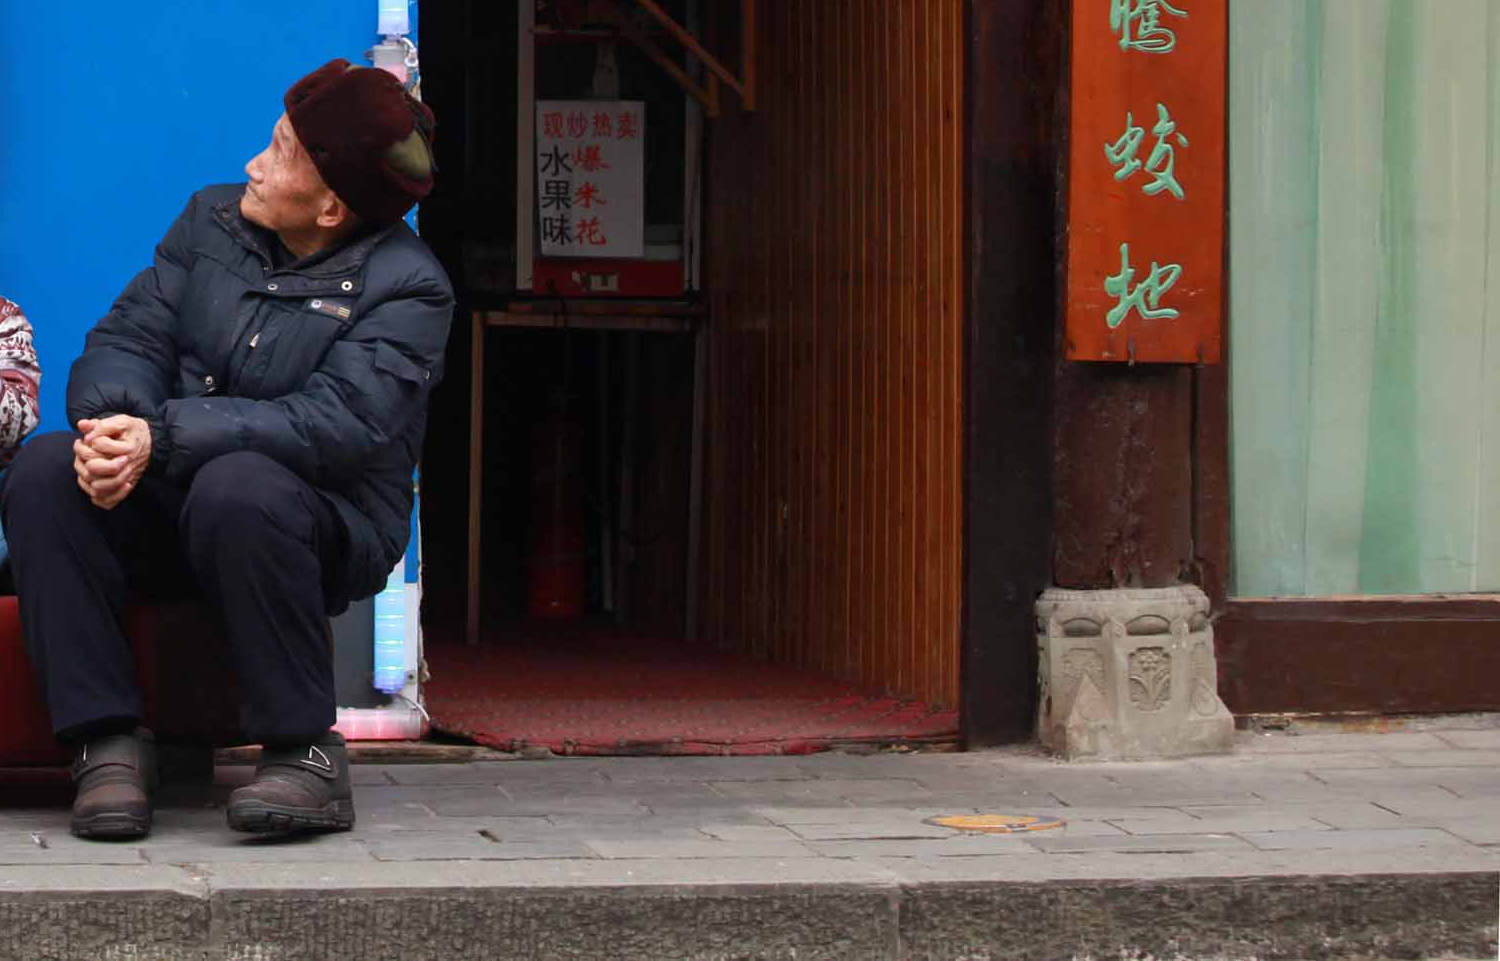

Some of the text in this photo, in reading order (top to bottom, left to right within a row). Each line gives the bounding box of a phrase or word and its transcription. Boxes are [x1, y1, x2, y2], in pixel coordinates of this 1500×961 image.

[542, 112, 638, 140] 现炒热卖
[540, 145, 573, 246] 水果味
[572, 145, 612, 246] 爆米花
